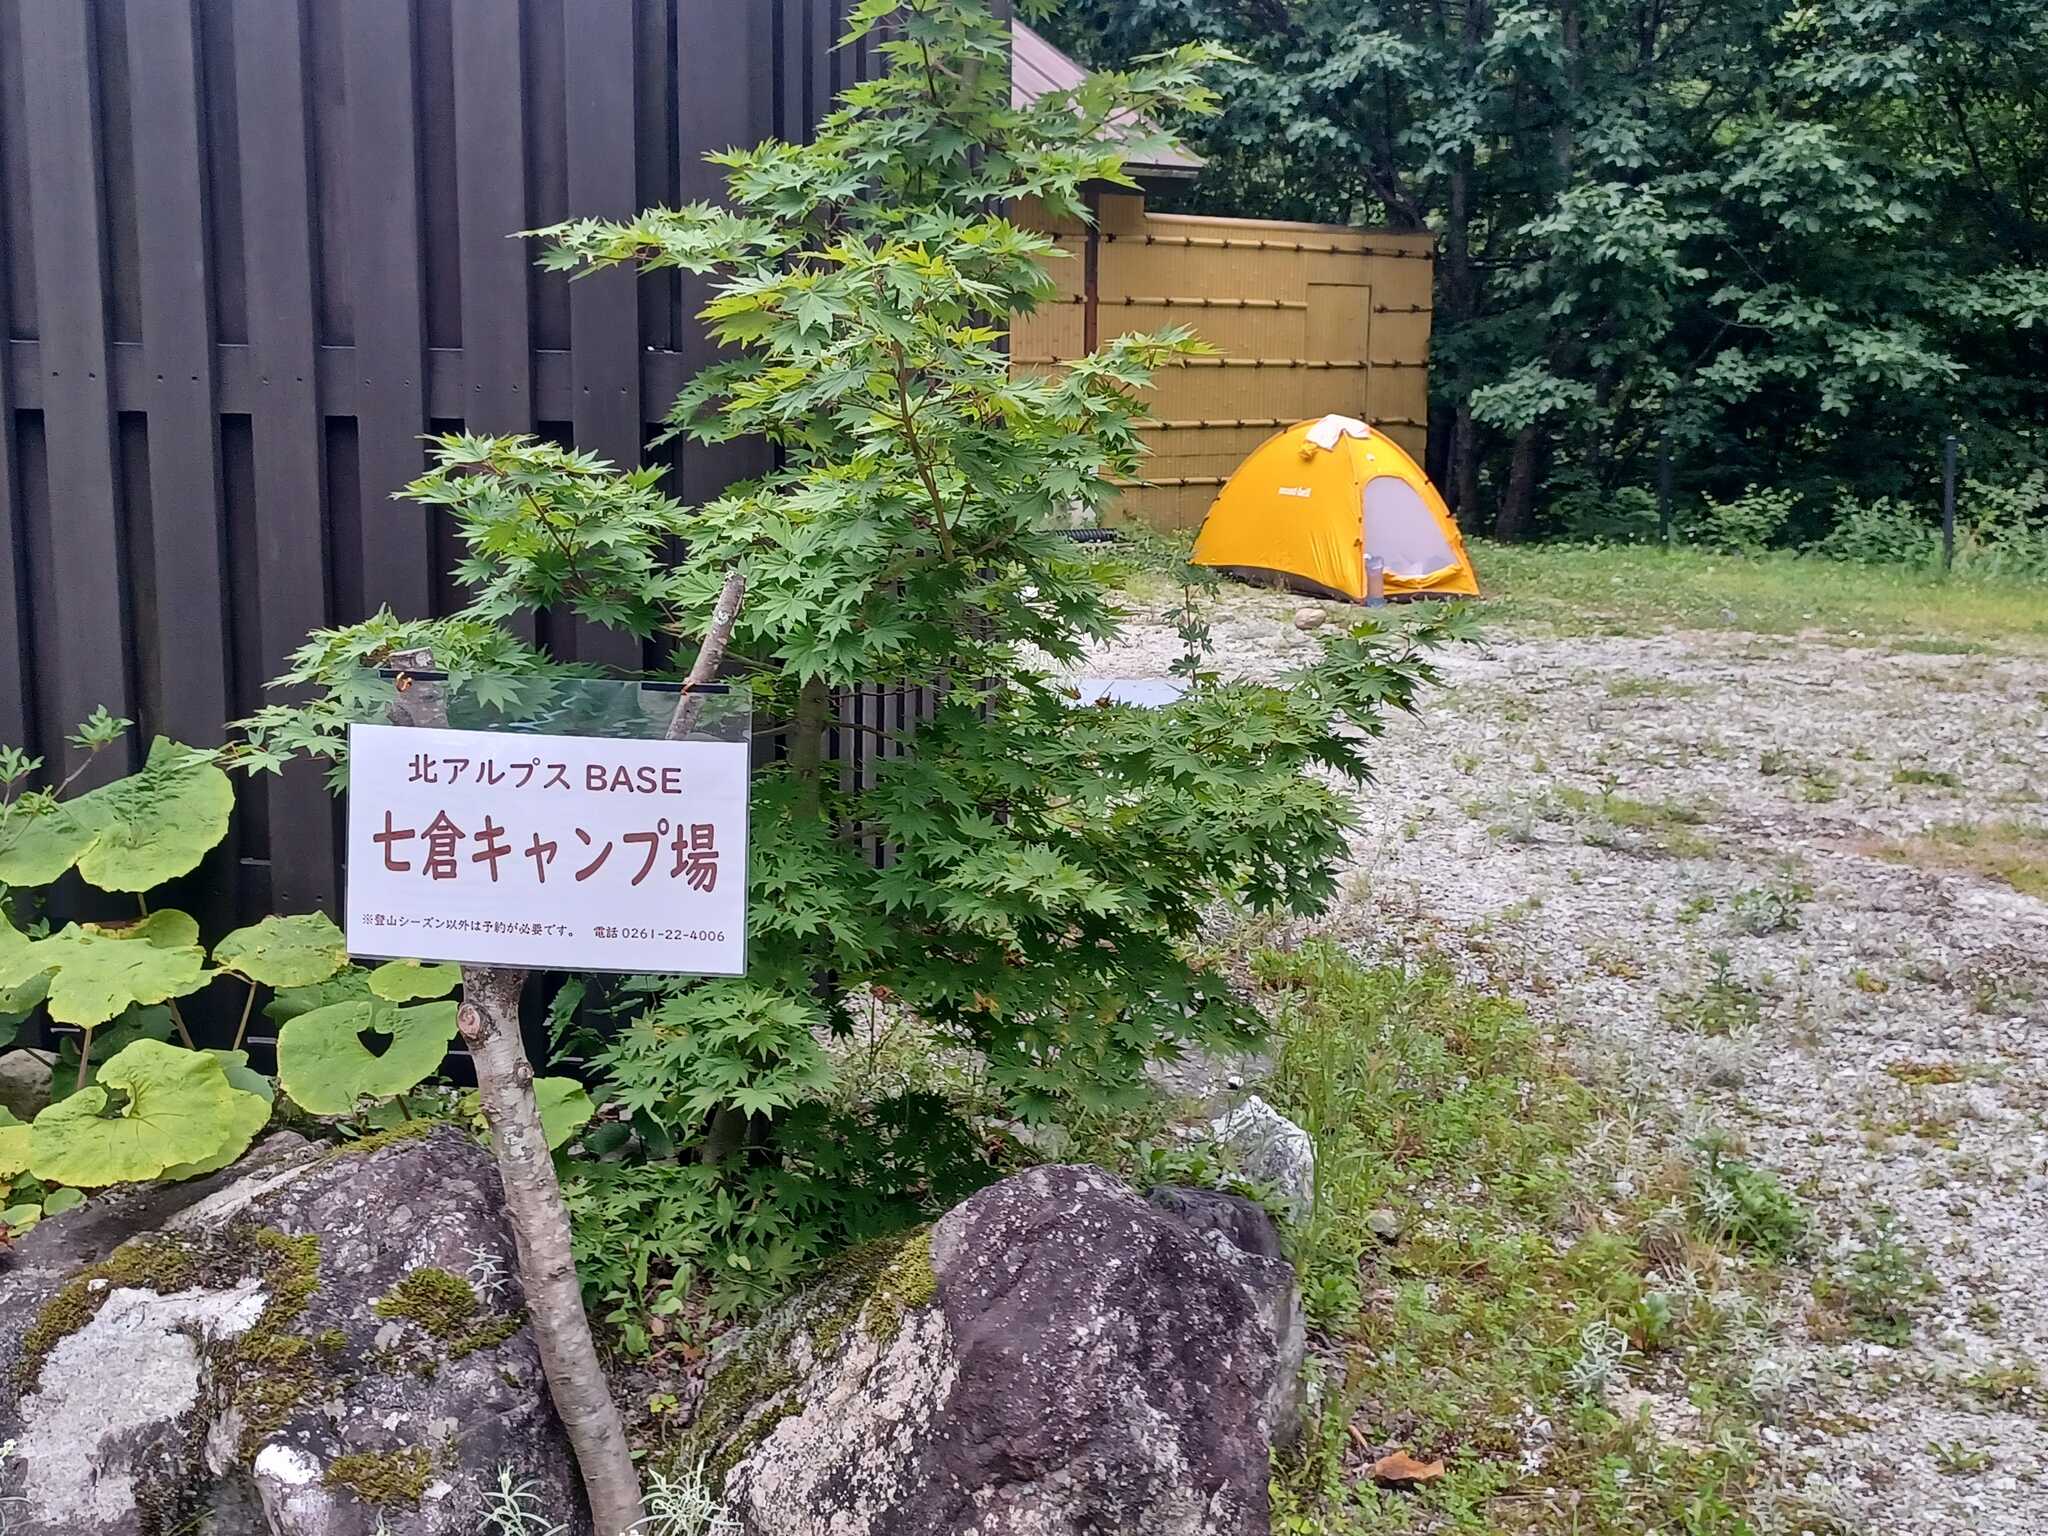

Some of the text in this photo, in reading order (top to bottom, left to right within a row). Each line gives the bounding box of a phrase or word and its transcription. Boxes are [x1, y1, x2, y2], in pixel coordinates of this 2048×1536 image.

[409, 754, 683, 795] 北アルプス BASE
[373, 810, 720, 893] 七倉キャンプ場
[593, 926, 619, 939] 電話
[622, 927, 725, 942] 0261-22-4006
